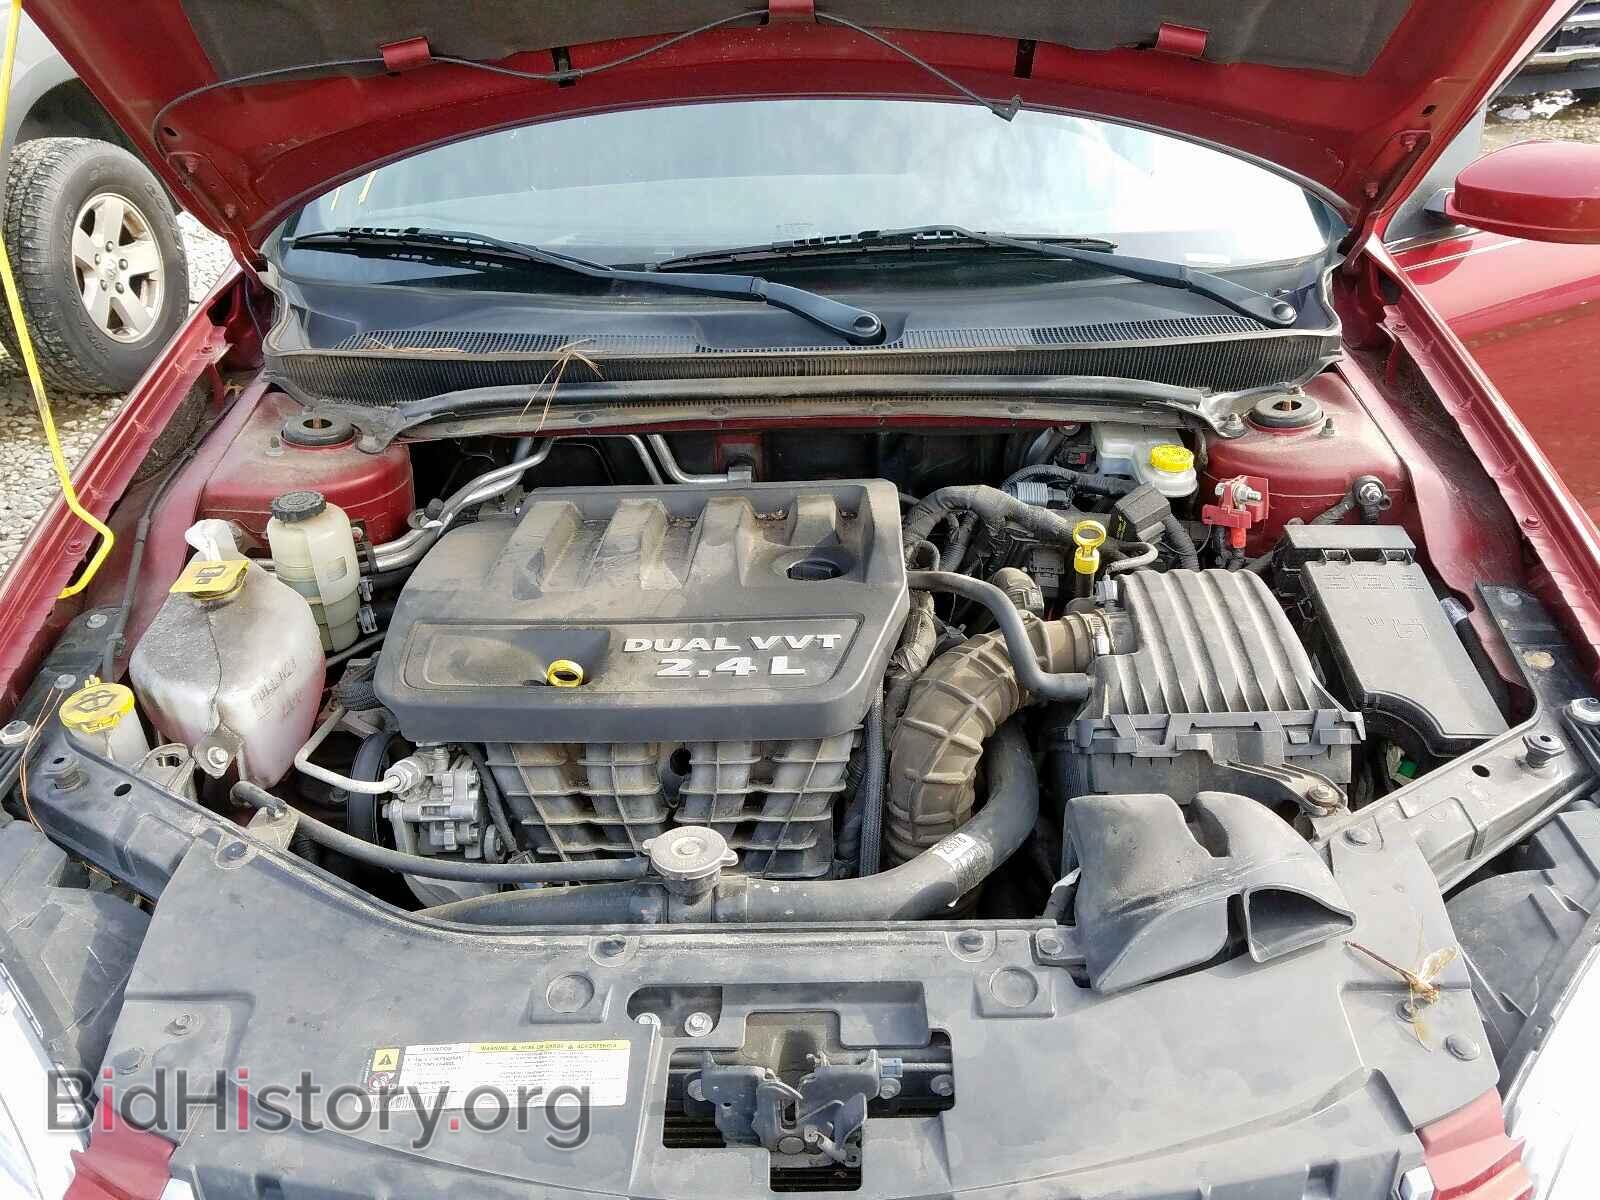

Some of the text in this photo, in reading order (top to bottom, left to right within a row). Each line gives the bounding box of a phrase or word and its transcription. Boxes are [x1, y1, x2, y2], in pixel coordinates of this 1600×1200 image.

[623, 634, 841, 653] DUAL VVT
[656, 655, 808, 678] 2.4 L
